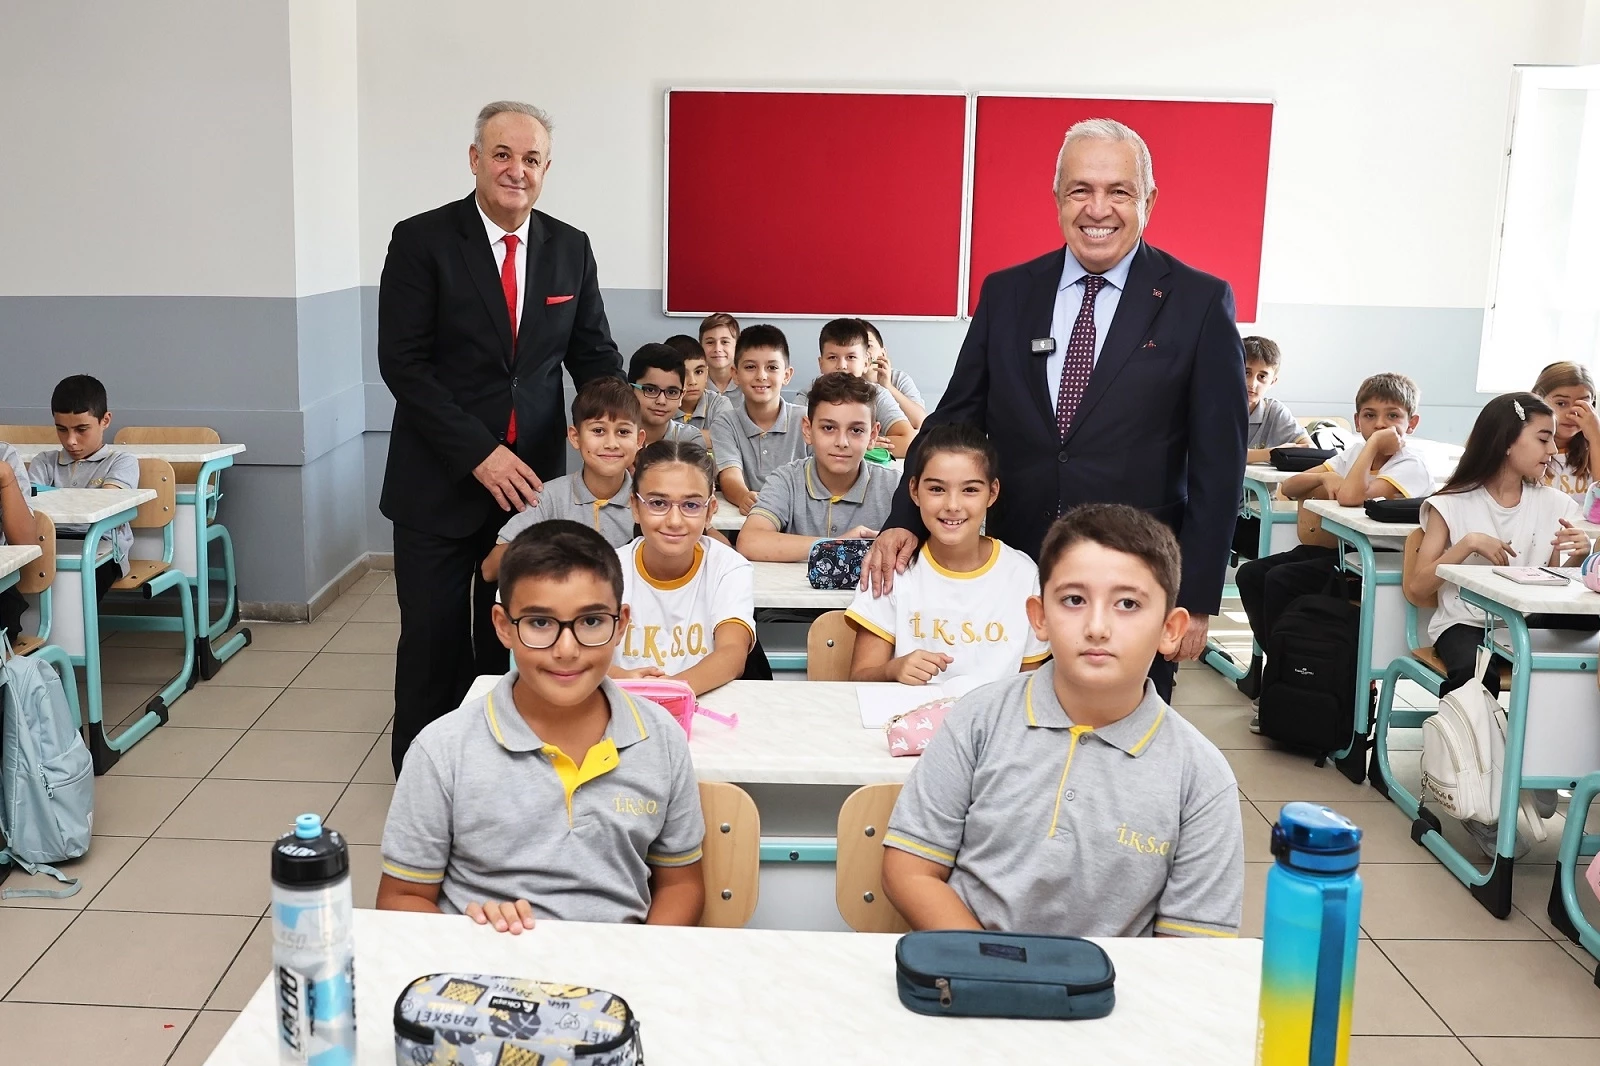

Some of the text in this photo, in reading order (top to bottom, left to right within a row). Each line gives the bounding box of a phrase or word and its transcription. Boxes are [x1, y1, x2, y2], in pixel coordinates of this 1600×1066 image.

[908, 611, 1009, 646] İ.K.S.O.
[612, 791, 659, 816] İ.K.S.O.
[491, 998, 521, 1009] Okapi
